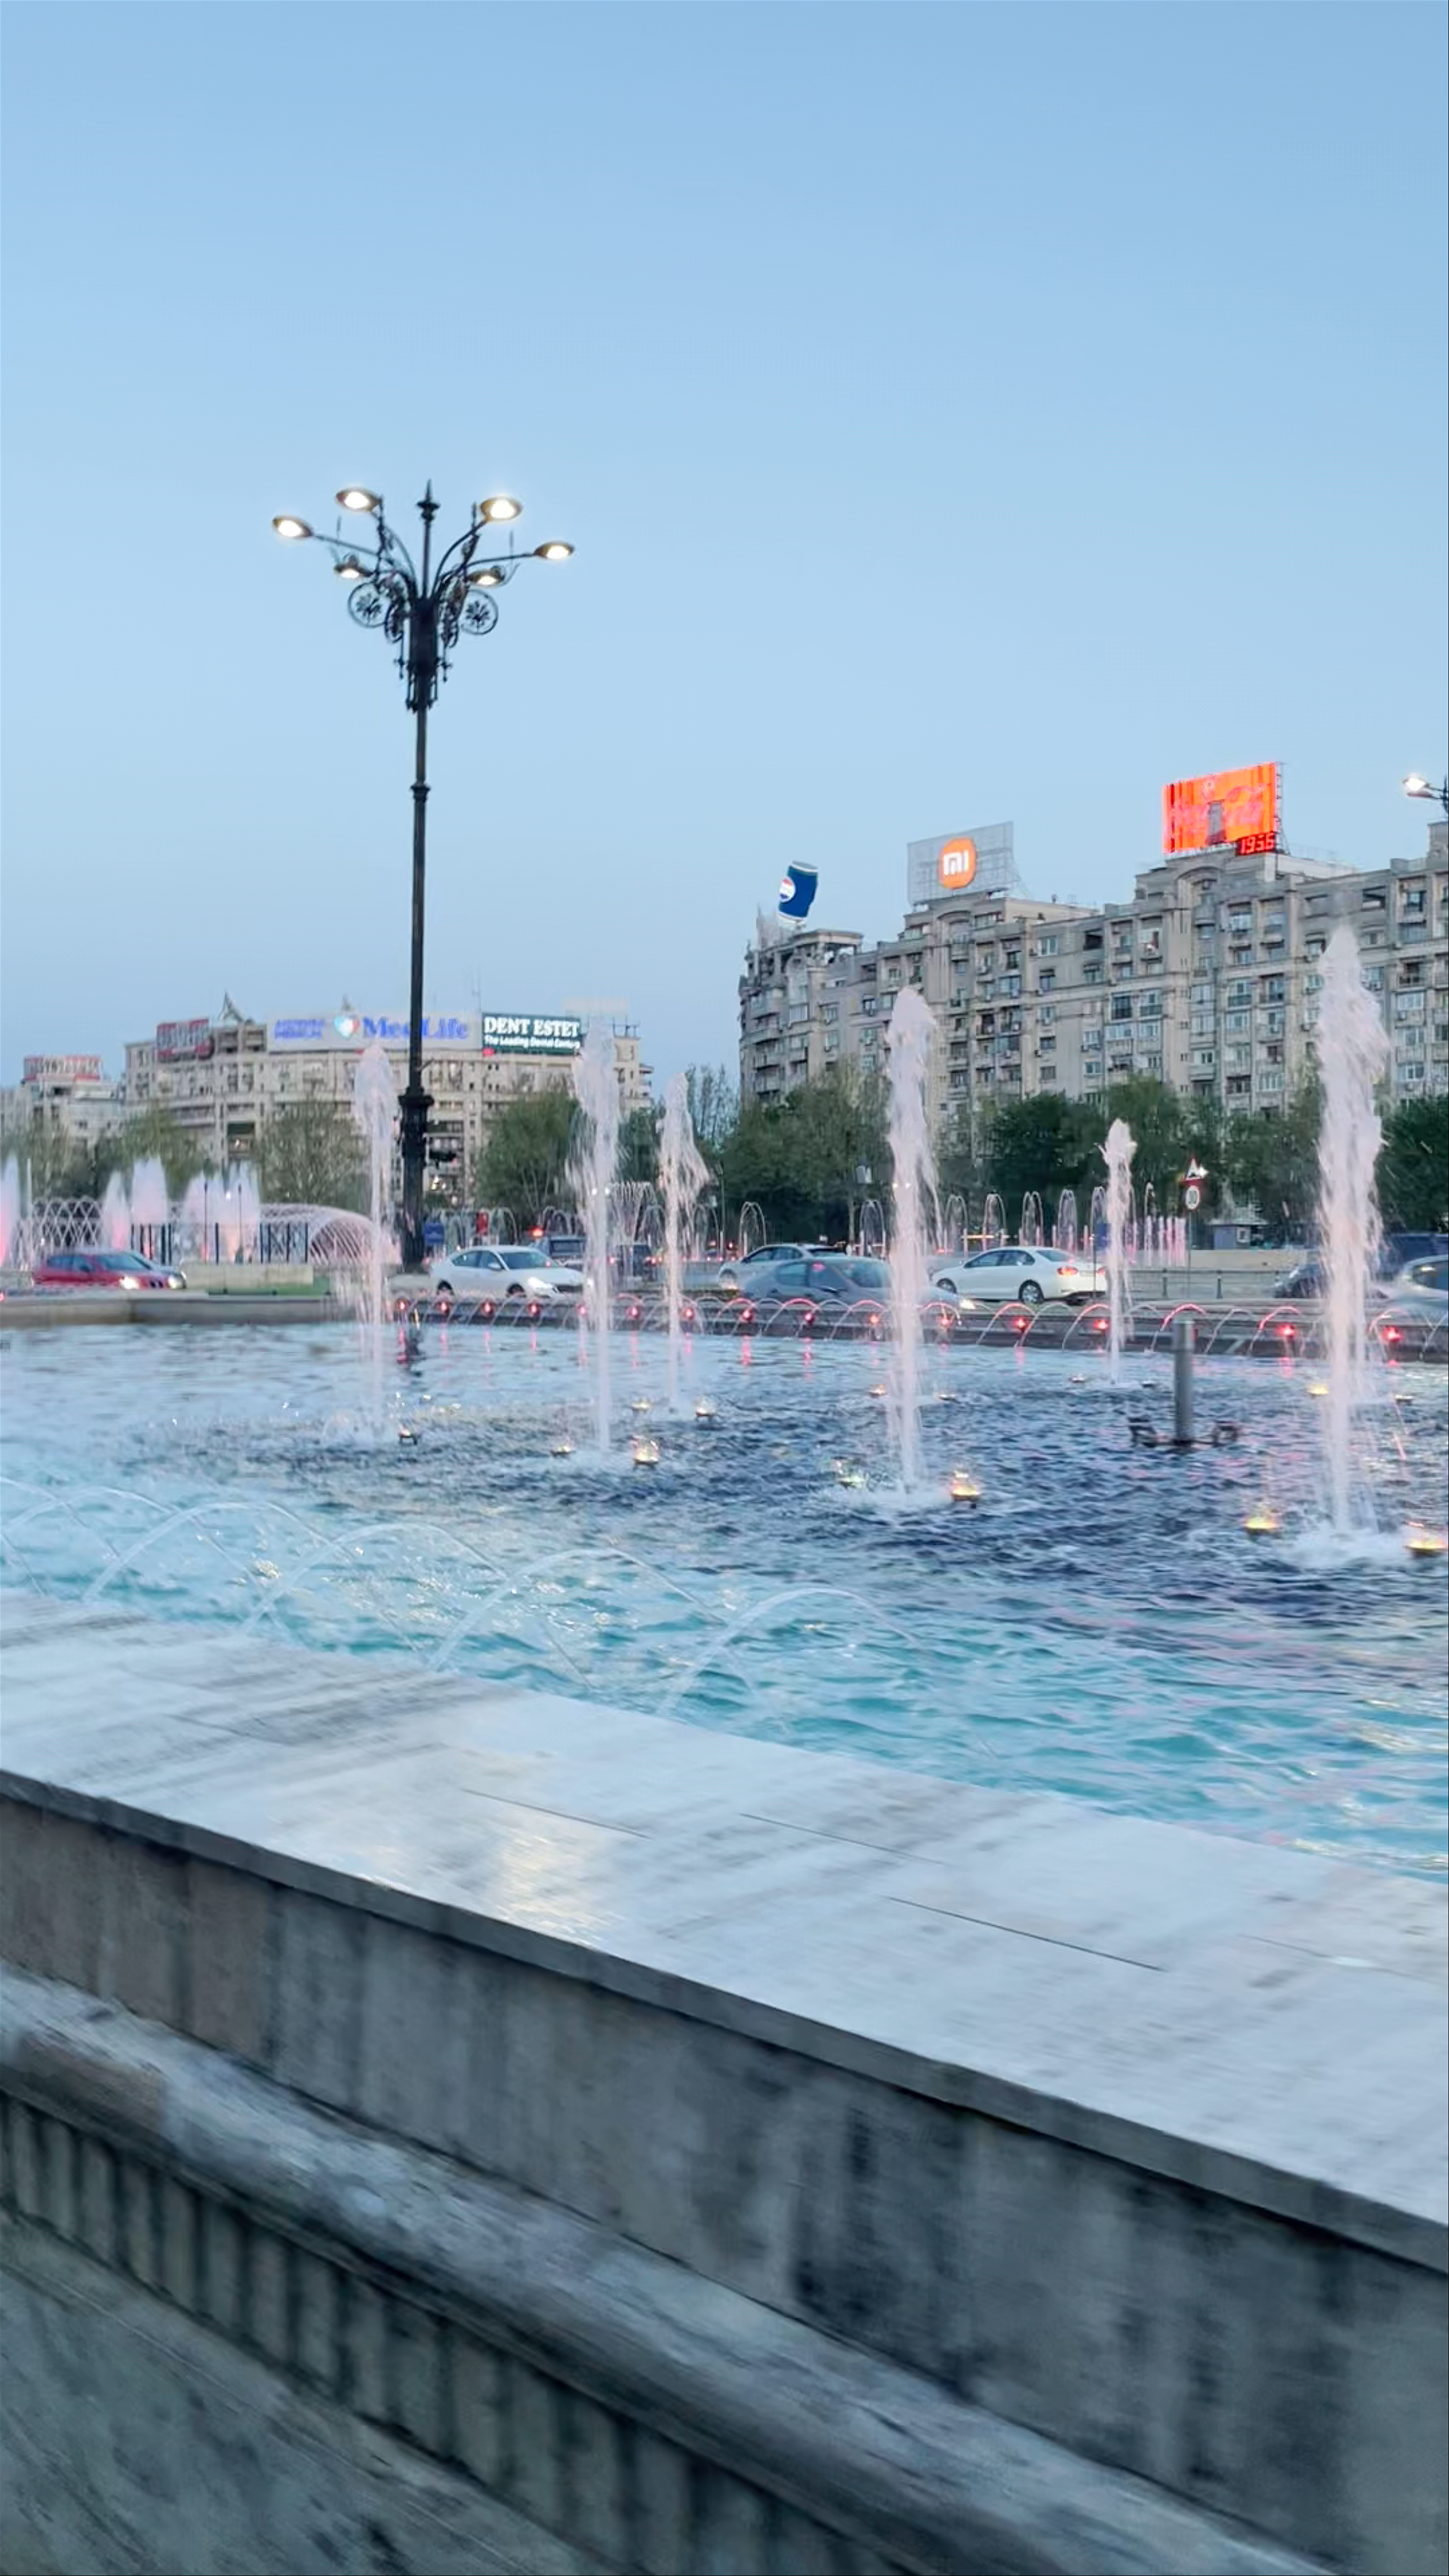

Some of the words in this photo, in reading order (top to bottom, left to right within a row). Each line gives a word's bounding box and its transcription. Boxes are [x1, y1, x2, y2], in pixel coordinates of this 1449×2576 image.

[484, 1016, 530, 1035] DENT
[533, 1019, 580, 1037] ESTET
[484, 1035, 498, 1045] The
